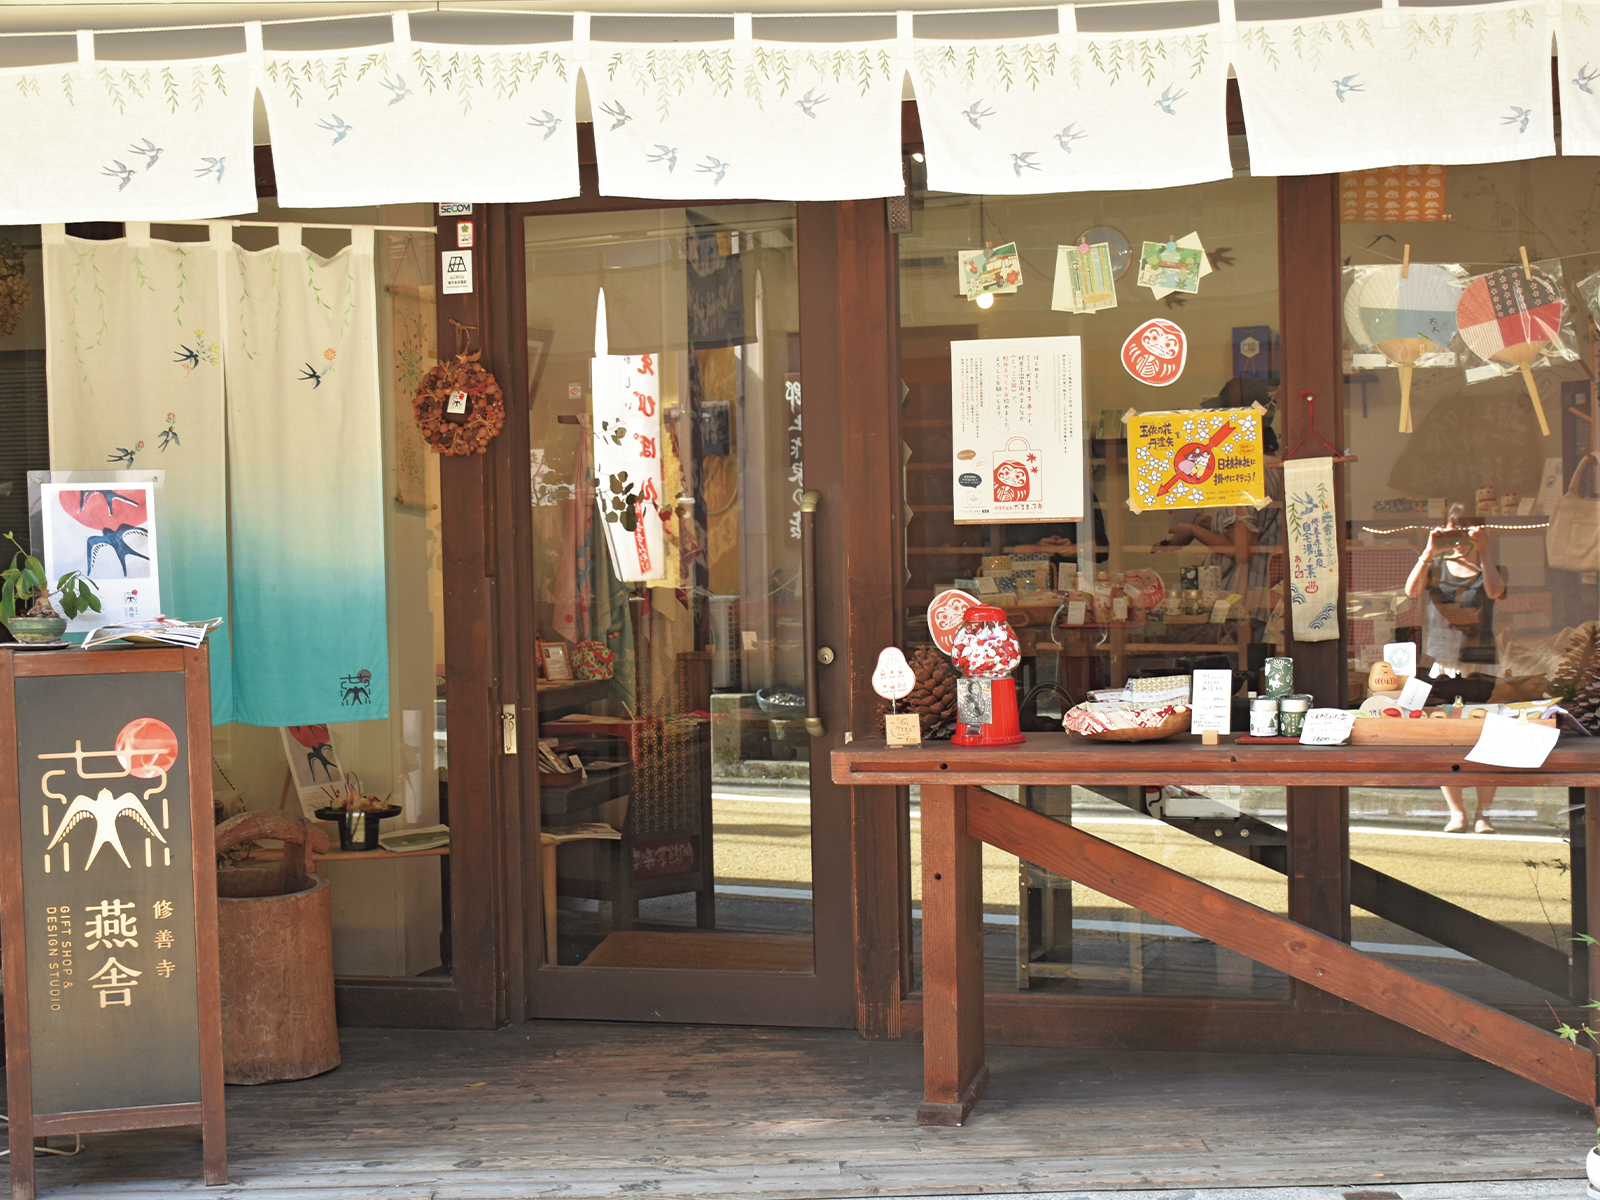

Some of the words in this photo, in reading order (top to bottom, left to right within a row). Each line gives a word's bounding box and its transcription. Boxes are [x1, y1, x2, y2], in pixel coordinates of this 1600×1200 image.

[441, 204, 470, 213] SECOM
[1217, 456, 1256, 470] 日枝神社に
[1311, 517, 1327, 568] 修善寺温泉
[46, 906, 59, 957] DESIGN
[60, 905, 72, 935] GIFT
[152, 899, 176, 979] 修善寺
[61, 941, 73, 976] SHOP
[84, 898, 143, 1009] 燕舎
[49, 963, 61, 1011] STUDIO
[63, 981, 73, 989] &
